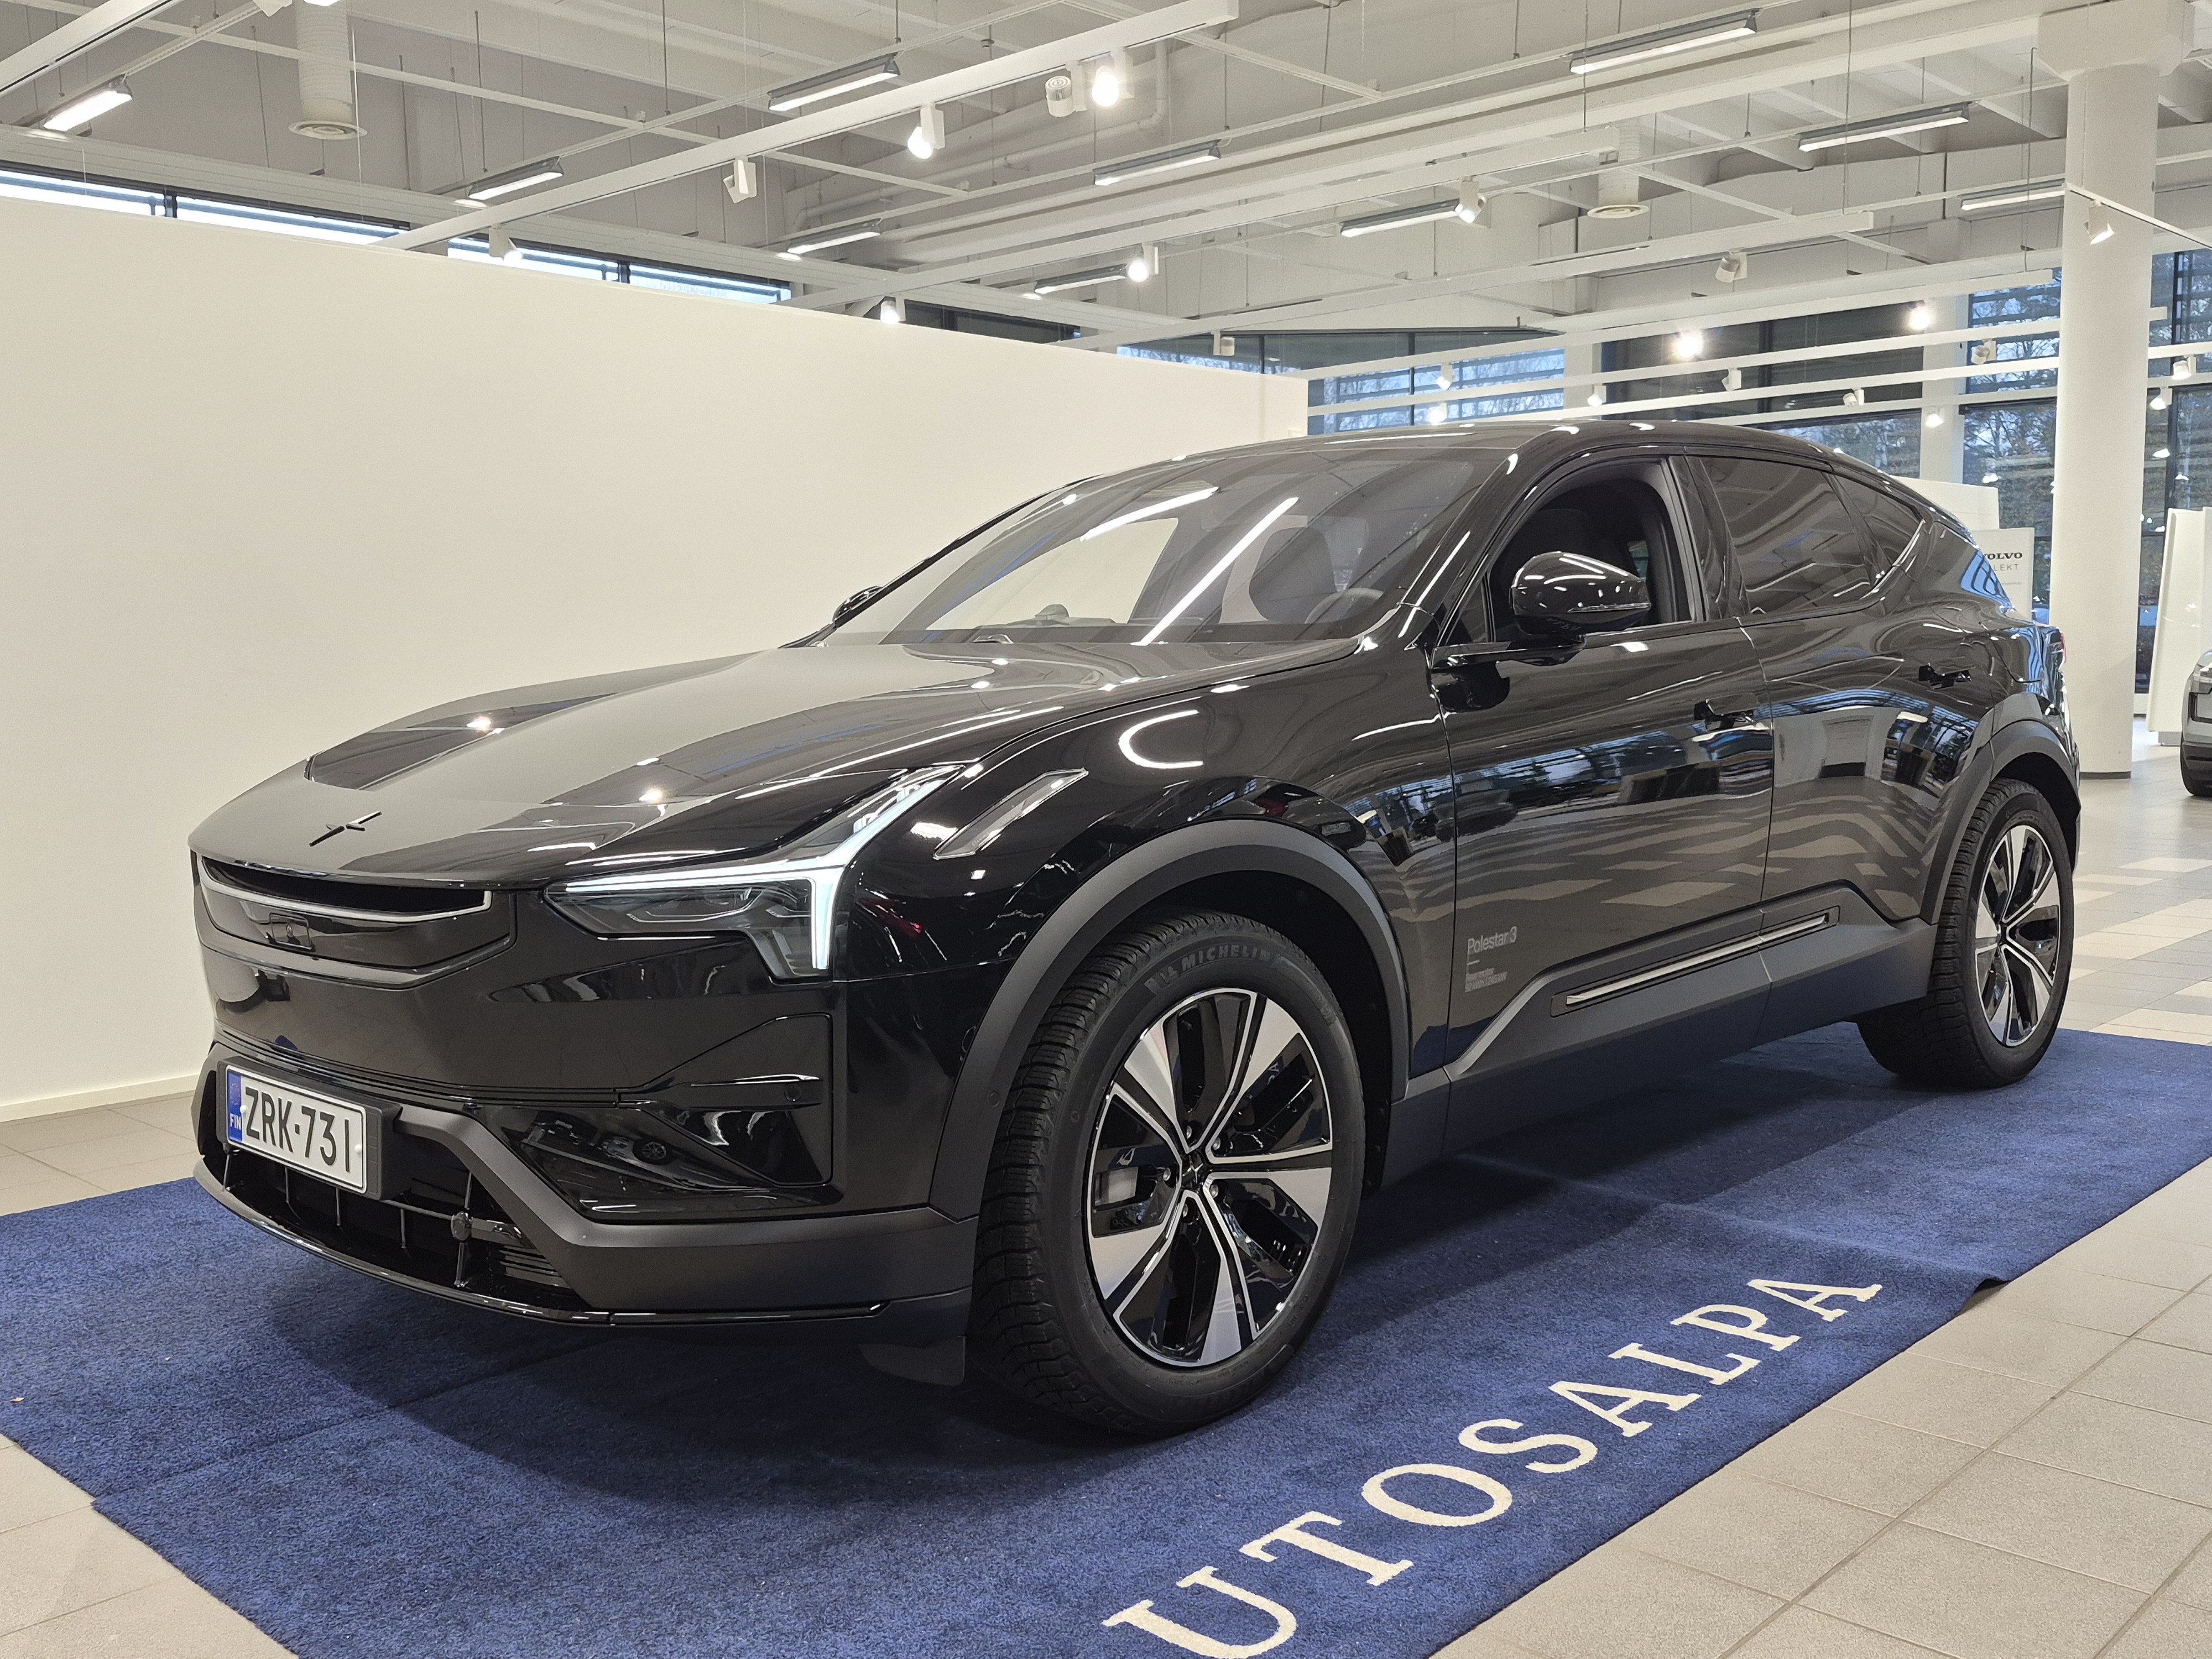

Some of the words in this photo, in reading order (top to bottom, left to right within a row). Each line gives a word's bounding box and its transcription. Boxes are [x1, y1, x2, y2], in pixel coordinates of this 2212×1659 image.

[1467, 932, 1508, 954] Polestar
[1510, 926, 1517, 943] 3
[1182, 945, 1271, 972] MICHELIN
[229, 1113, 242, 1131] FIN
[246, 1086, 350, 1173] ZRK-731
[1102, 1279, 1883, 1658] UTOSALPA
